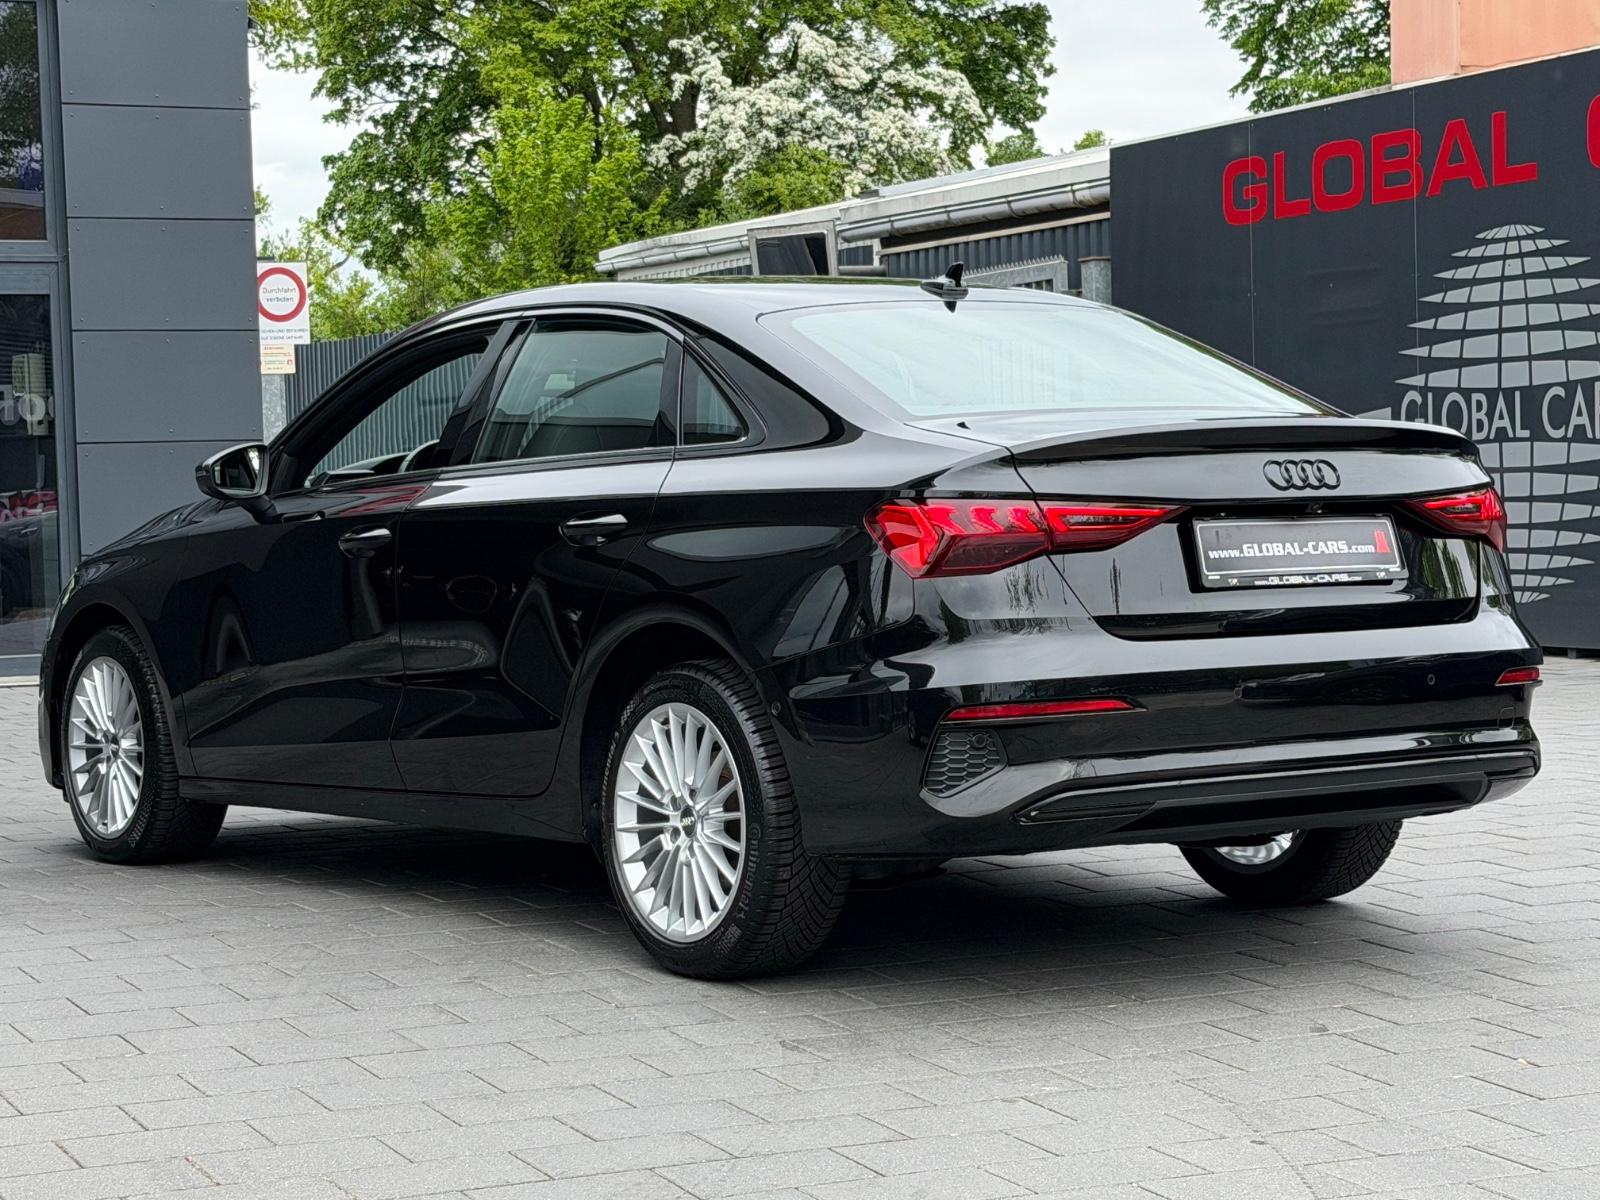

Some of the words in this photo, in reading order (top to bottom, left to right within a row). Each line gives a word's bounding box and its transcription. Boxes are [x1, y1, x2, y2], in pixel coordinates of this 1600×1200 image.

[1222, 110, 1539, 226] GLOBAL
[262, 287, 297, 295] Durchfahrt
[1400, 388, 1531, 441] GLOBAL
[1208, 540, 1376, 560] www.GLOBAL-CARS.com
